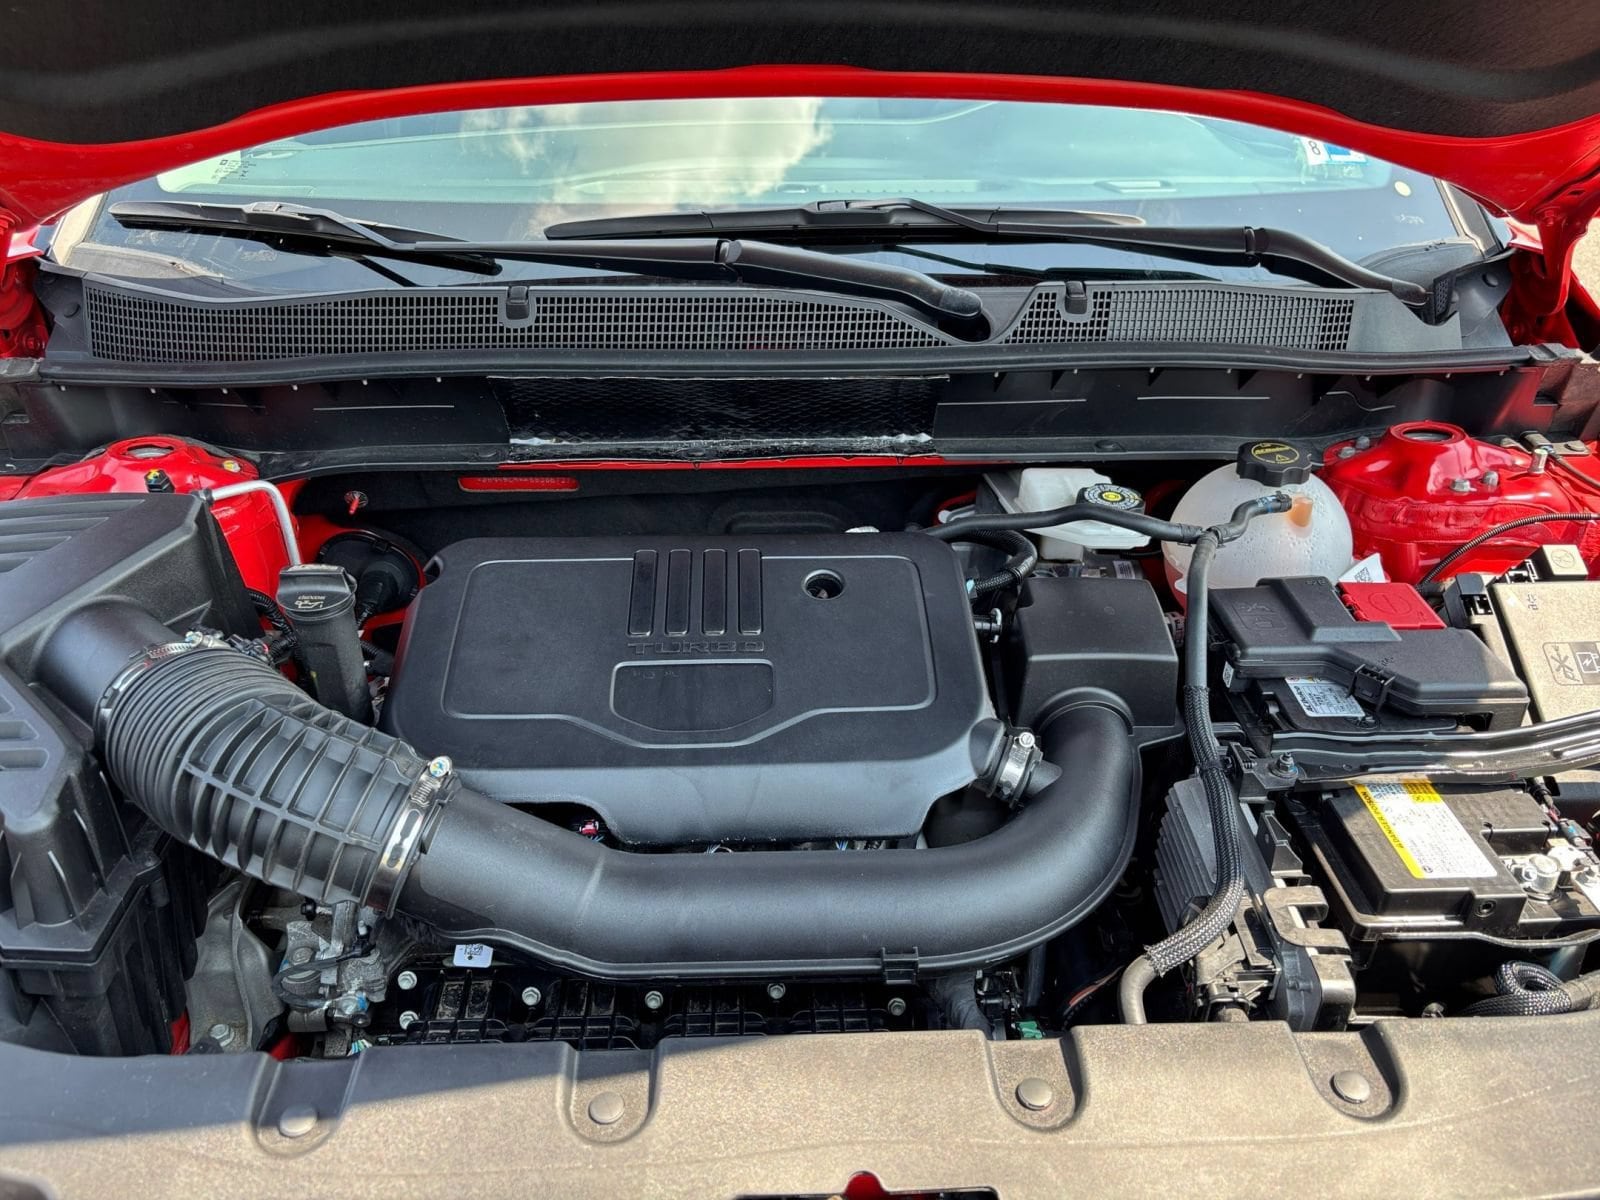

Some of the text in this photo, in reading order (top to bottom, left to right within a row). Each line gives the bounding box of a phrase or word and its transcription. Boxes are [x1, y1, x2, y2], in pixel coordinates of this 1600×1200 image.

[627, 640, 765, 656] TURBO
[1361, 791, 1402, 844] DANGER POISON
